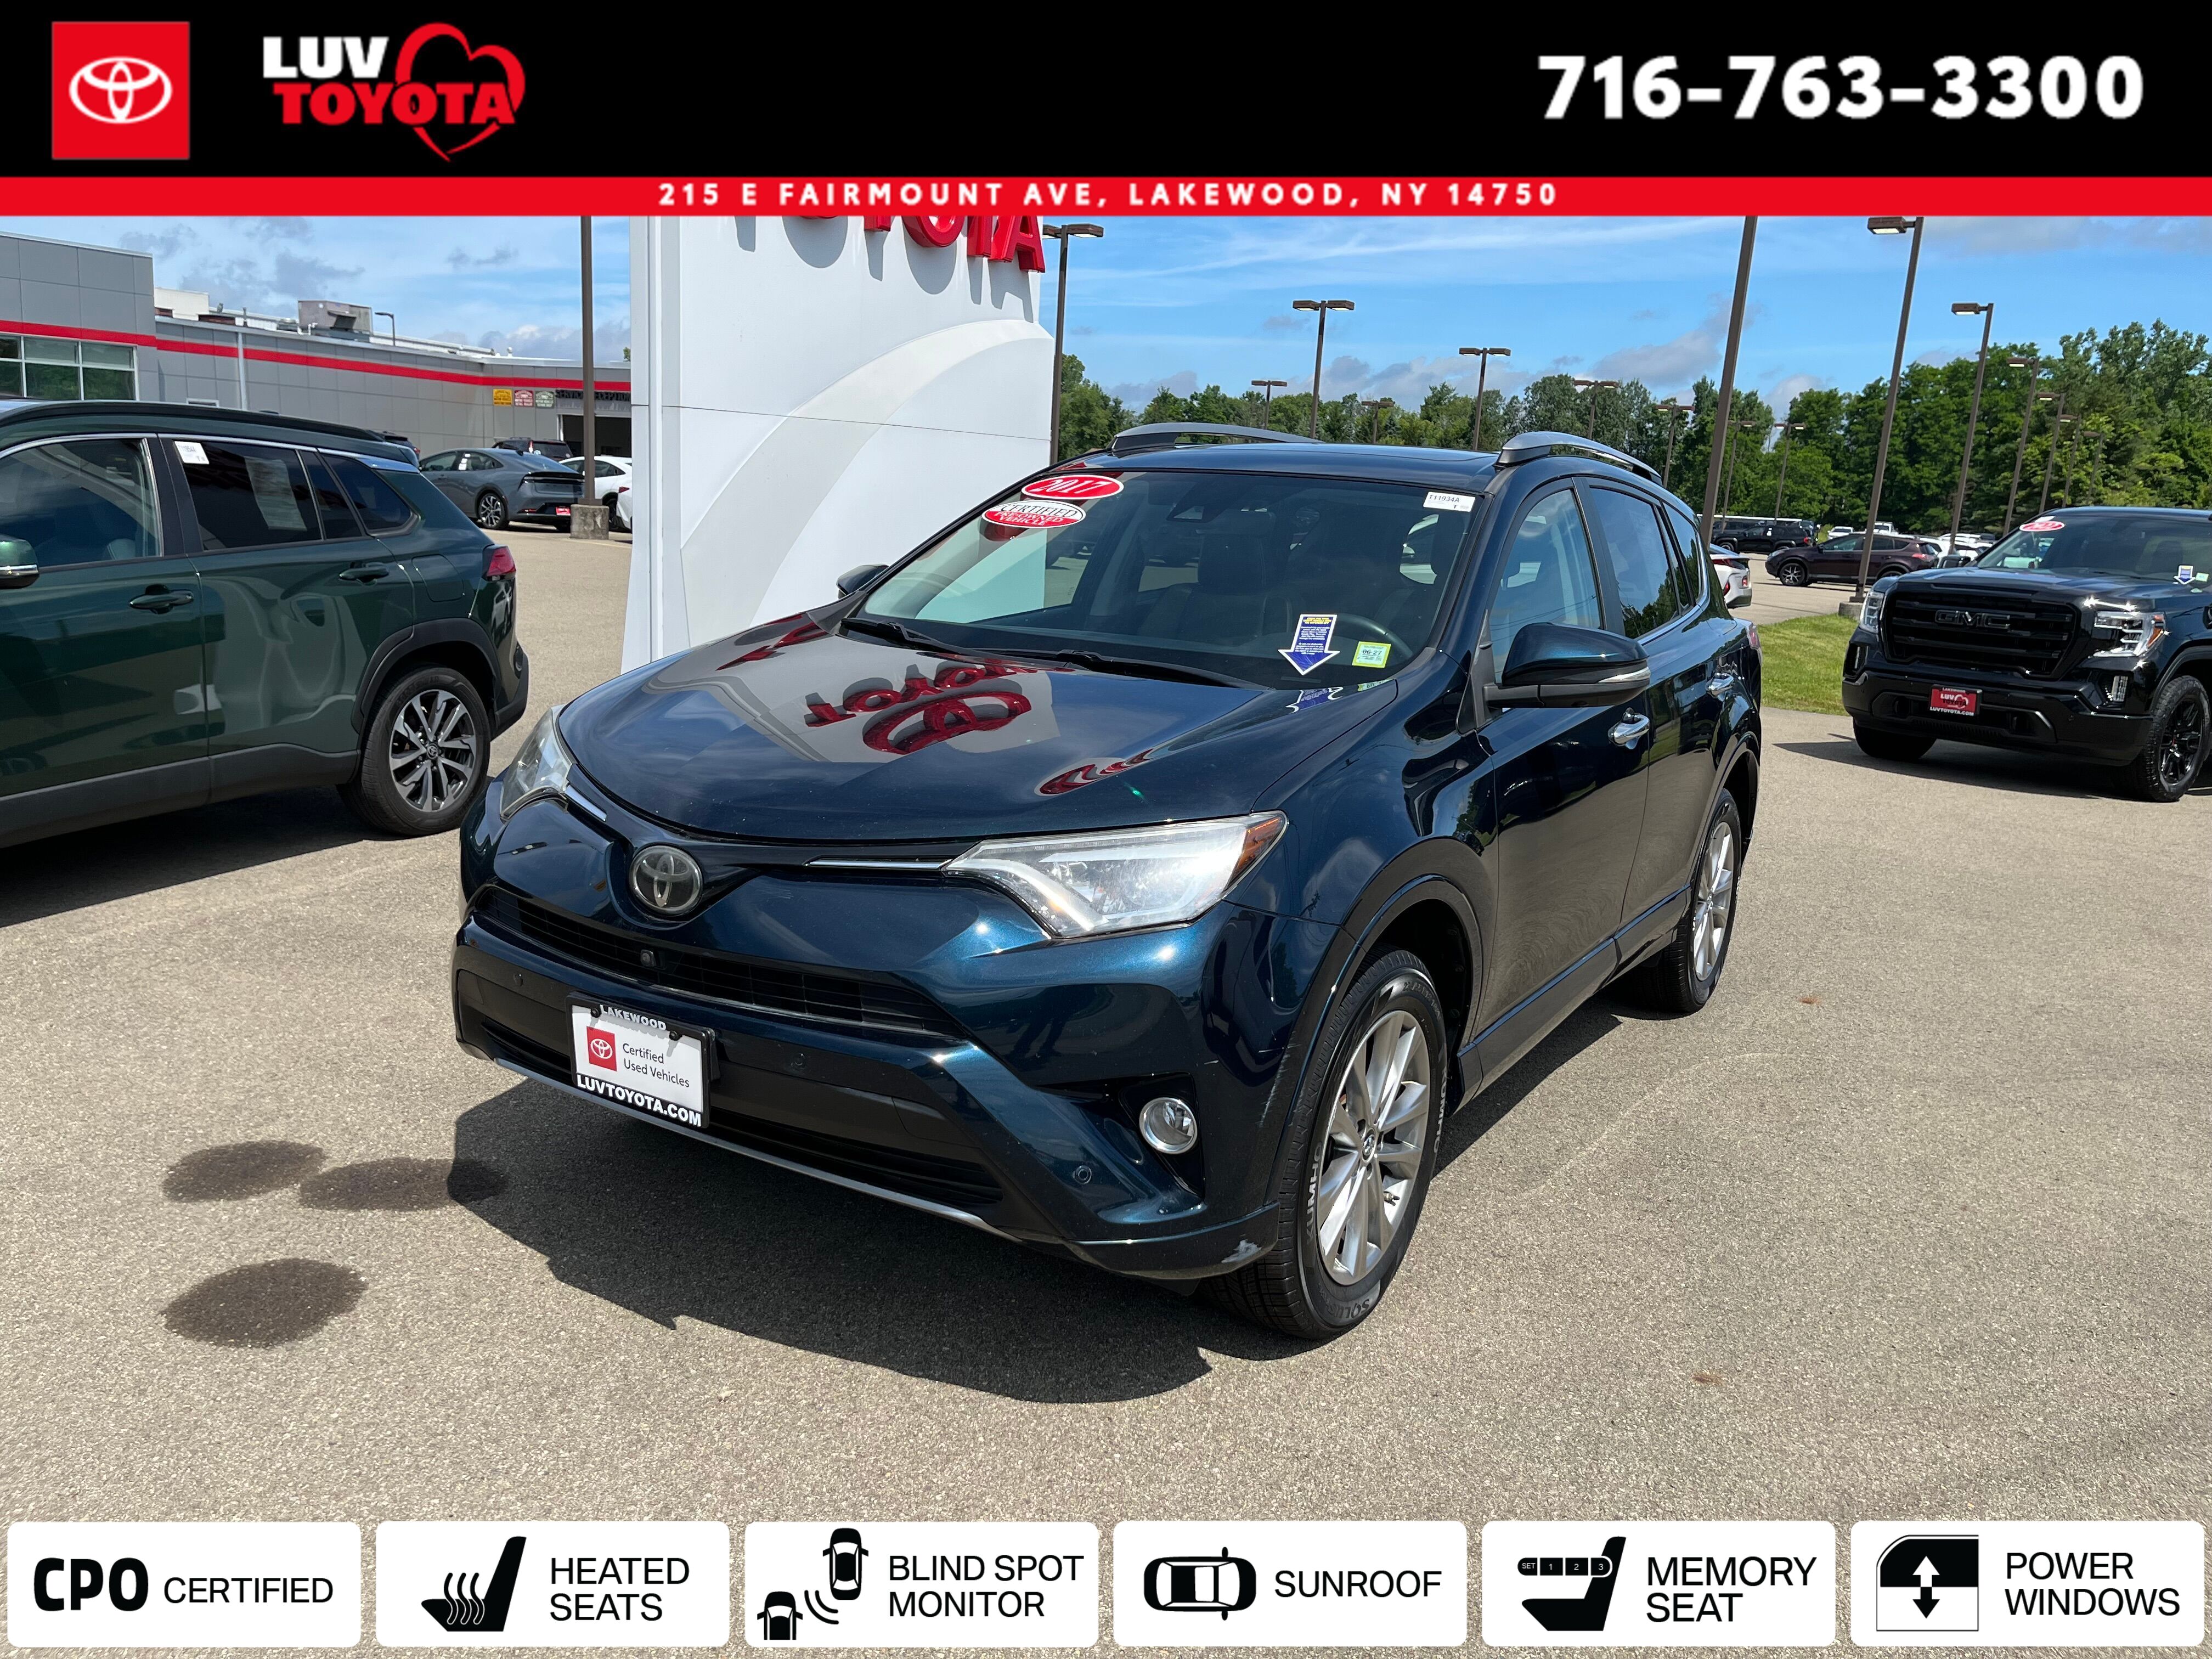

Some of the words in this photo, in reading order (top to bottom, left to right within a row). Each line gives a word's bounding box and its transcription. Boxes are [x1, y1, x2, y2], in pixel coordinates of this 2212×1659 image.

[1028, 479, 1113, 494] 2017
[1429, 494, 1460, 503] T11934A
[994, 511, 1064, 523] PRE-OWNED
[1001, 504, 1077, 519] CERTIFIED
[998, 516, 1047, 526] VEHICLE
[1935, 610, 2011, 630] GMC
[1930, 707, 1974, 716] LUVTOYOTA.COM
[600, 1005, 667, 1030] LAKEWOOD
[623, 1043, 664, 1064] Certified
[624, 1058, 647, 1075] Used
[650, 1066, 690, 1087] Vehicles
[577, 1074, 701, 1126] LUVTOYOTA.COM
[1306, 1141, 1322, 1244] KUMHO
